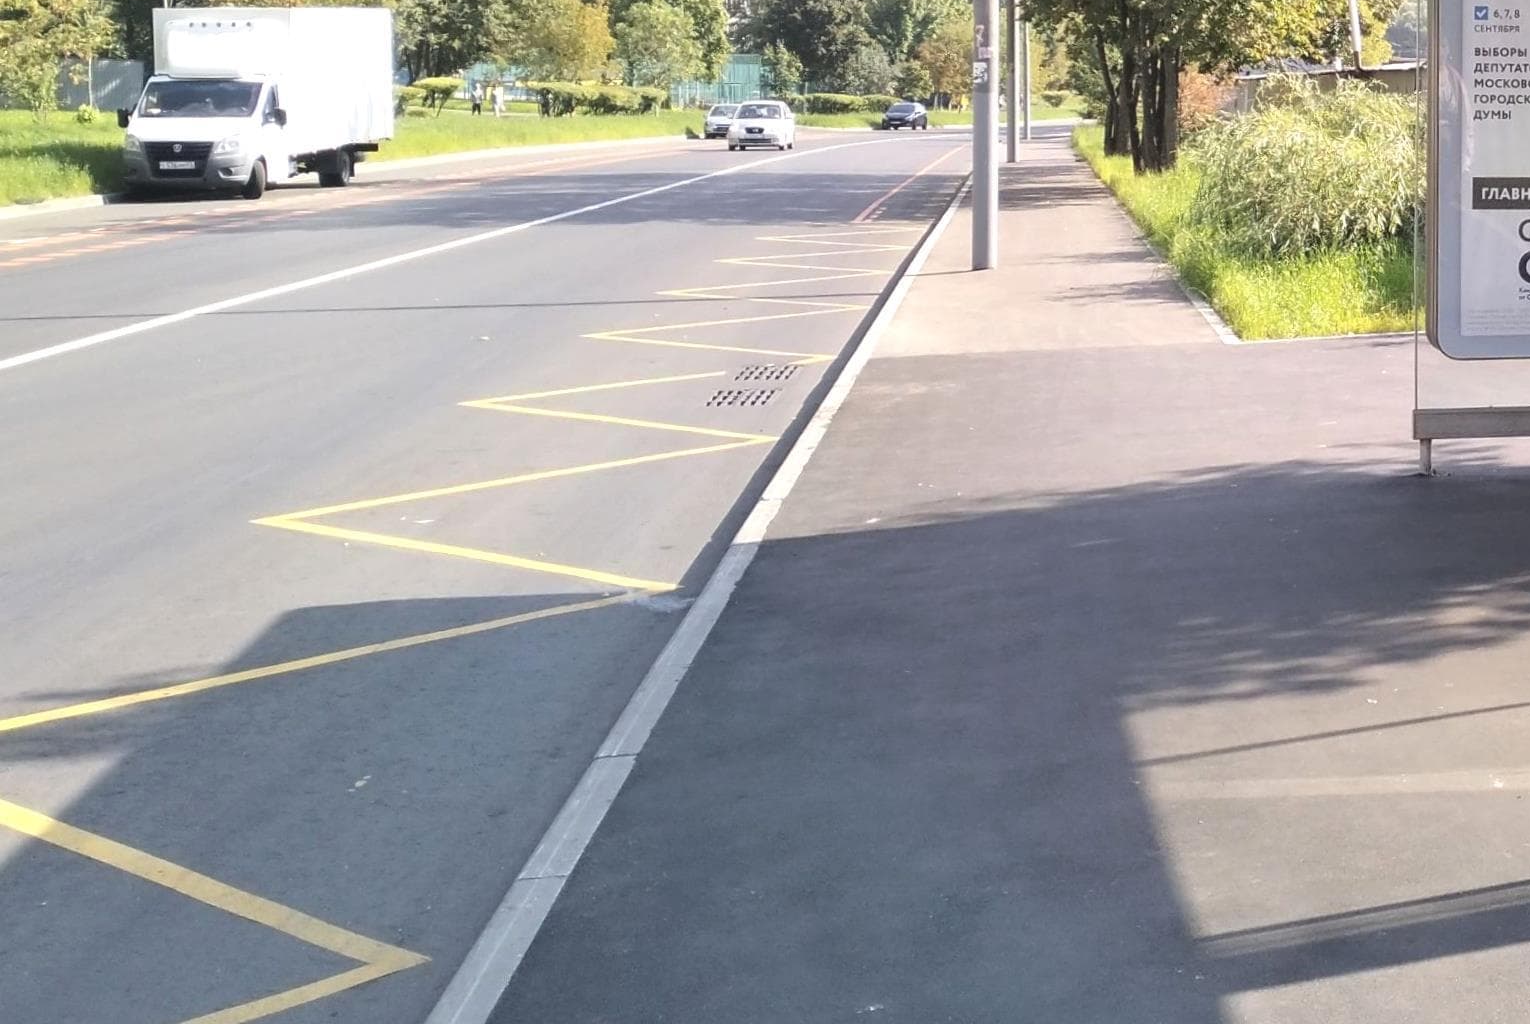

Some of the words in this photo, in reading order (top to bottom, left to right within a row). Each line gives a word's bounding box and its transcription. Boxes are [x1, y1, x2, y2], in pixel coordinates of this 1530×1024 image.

[1474, 24, 1520, 33] СЕНТЯБРЯ
[1474, 47, 1528, 57] ВЫБОРЫ
[1473, 109, 1512, 121] ДУМЫ
